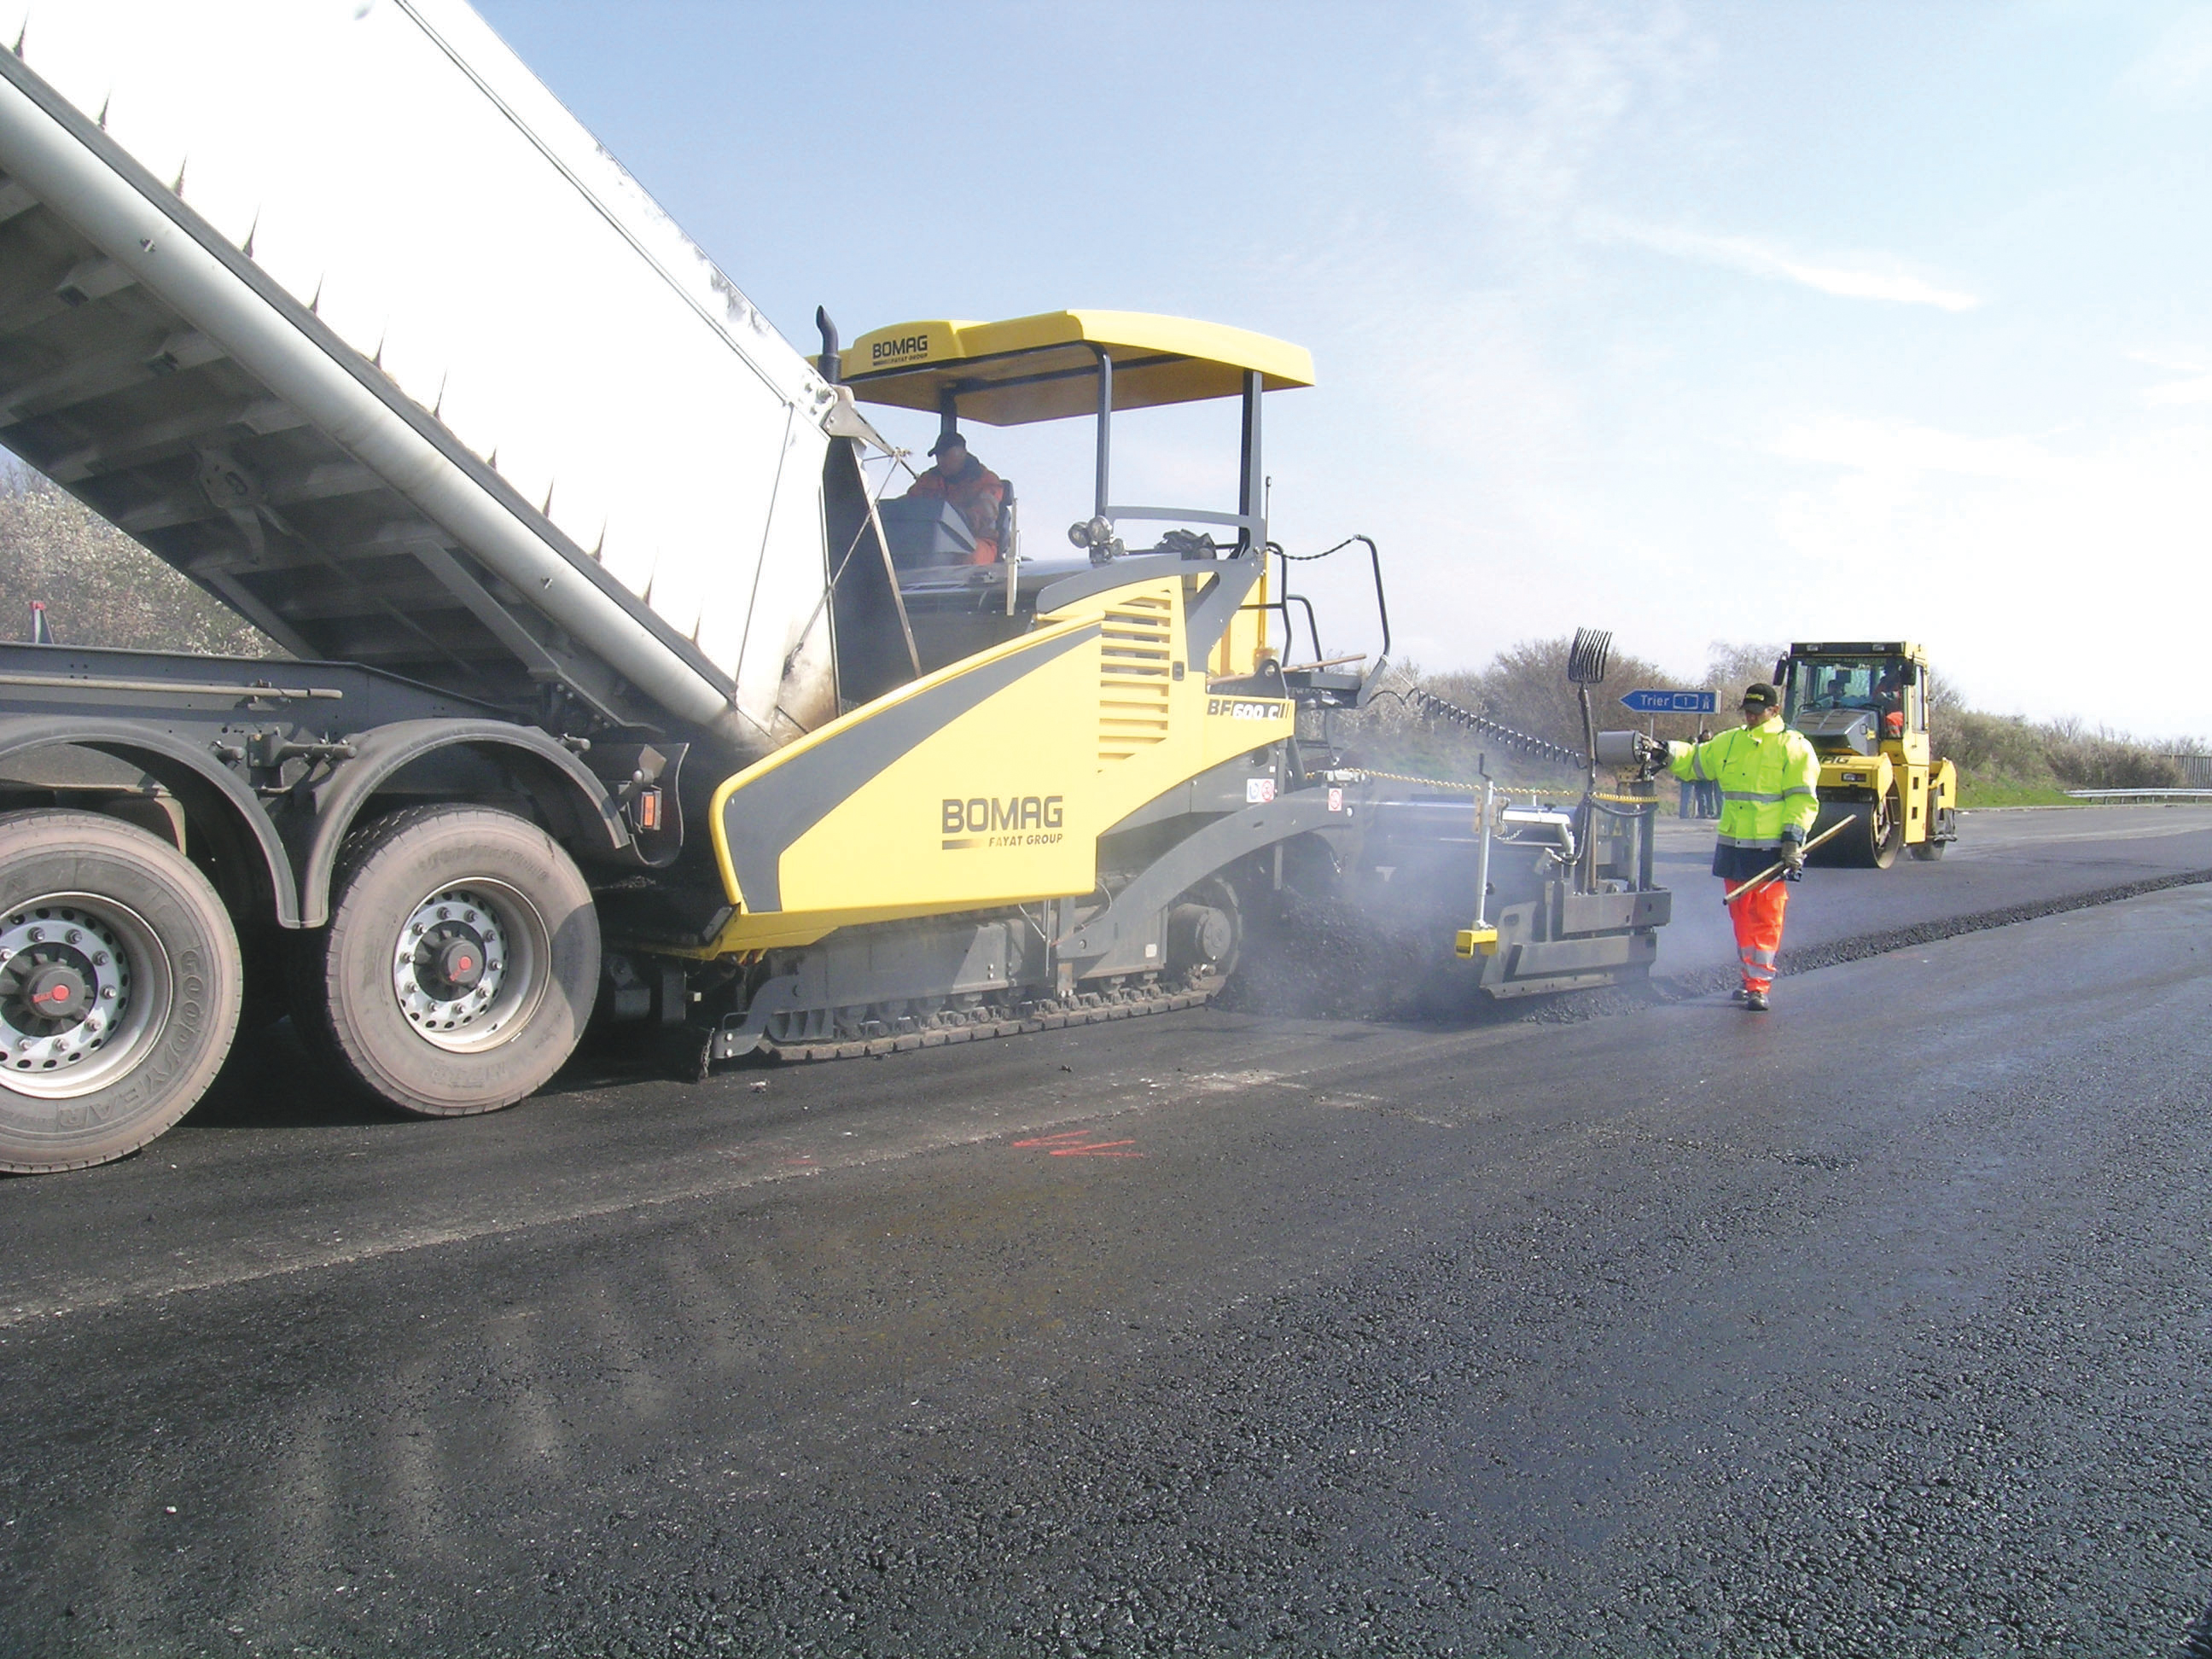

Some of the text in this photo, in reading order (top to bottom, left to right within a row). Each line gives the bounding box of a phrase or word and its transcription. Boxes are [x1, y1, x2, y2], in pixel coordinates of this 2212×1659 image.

[872, 335, 928, 359] BOMAG
[1640, 694, 1670, 707] Trier
[942, 795, 1063, 834] BOMAG
[988, 833, 1063, 847] FAYAT GROUP
[60, 949, 204, 1128] GOODYEAR
